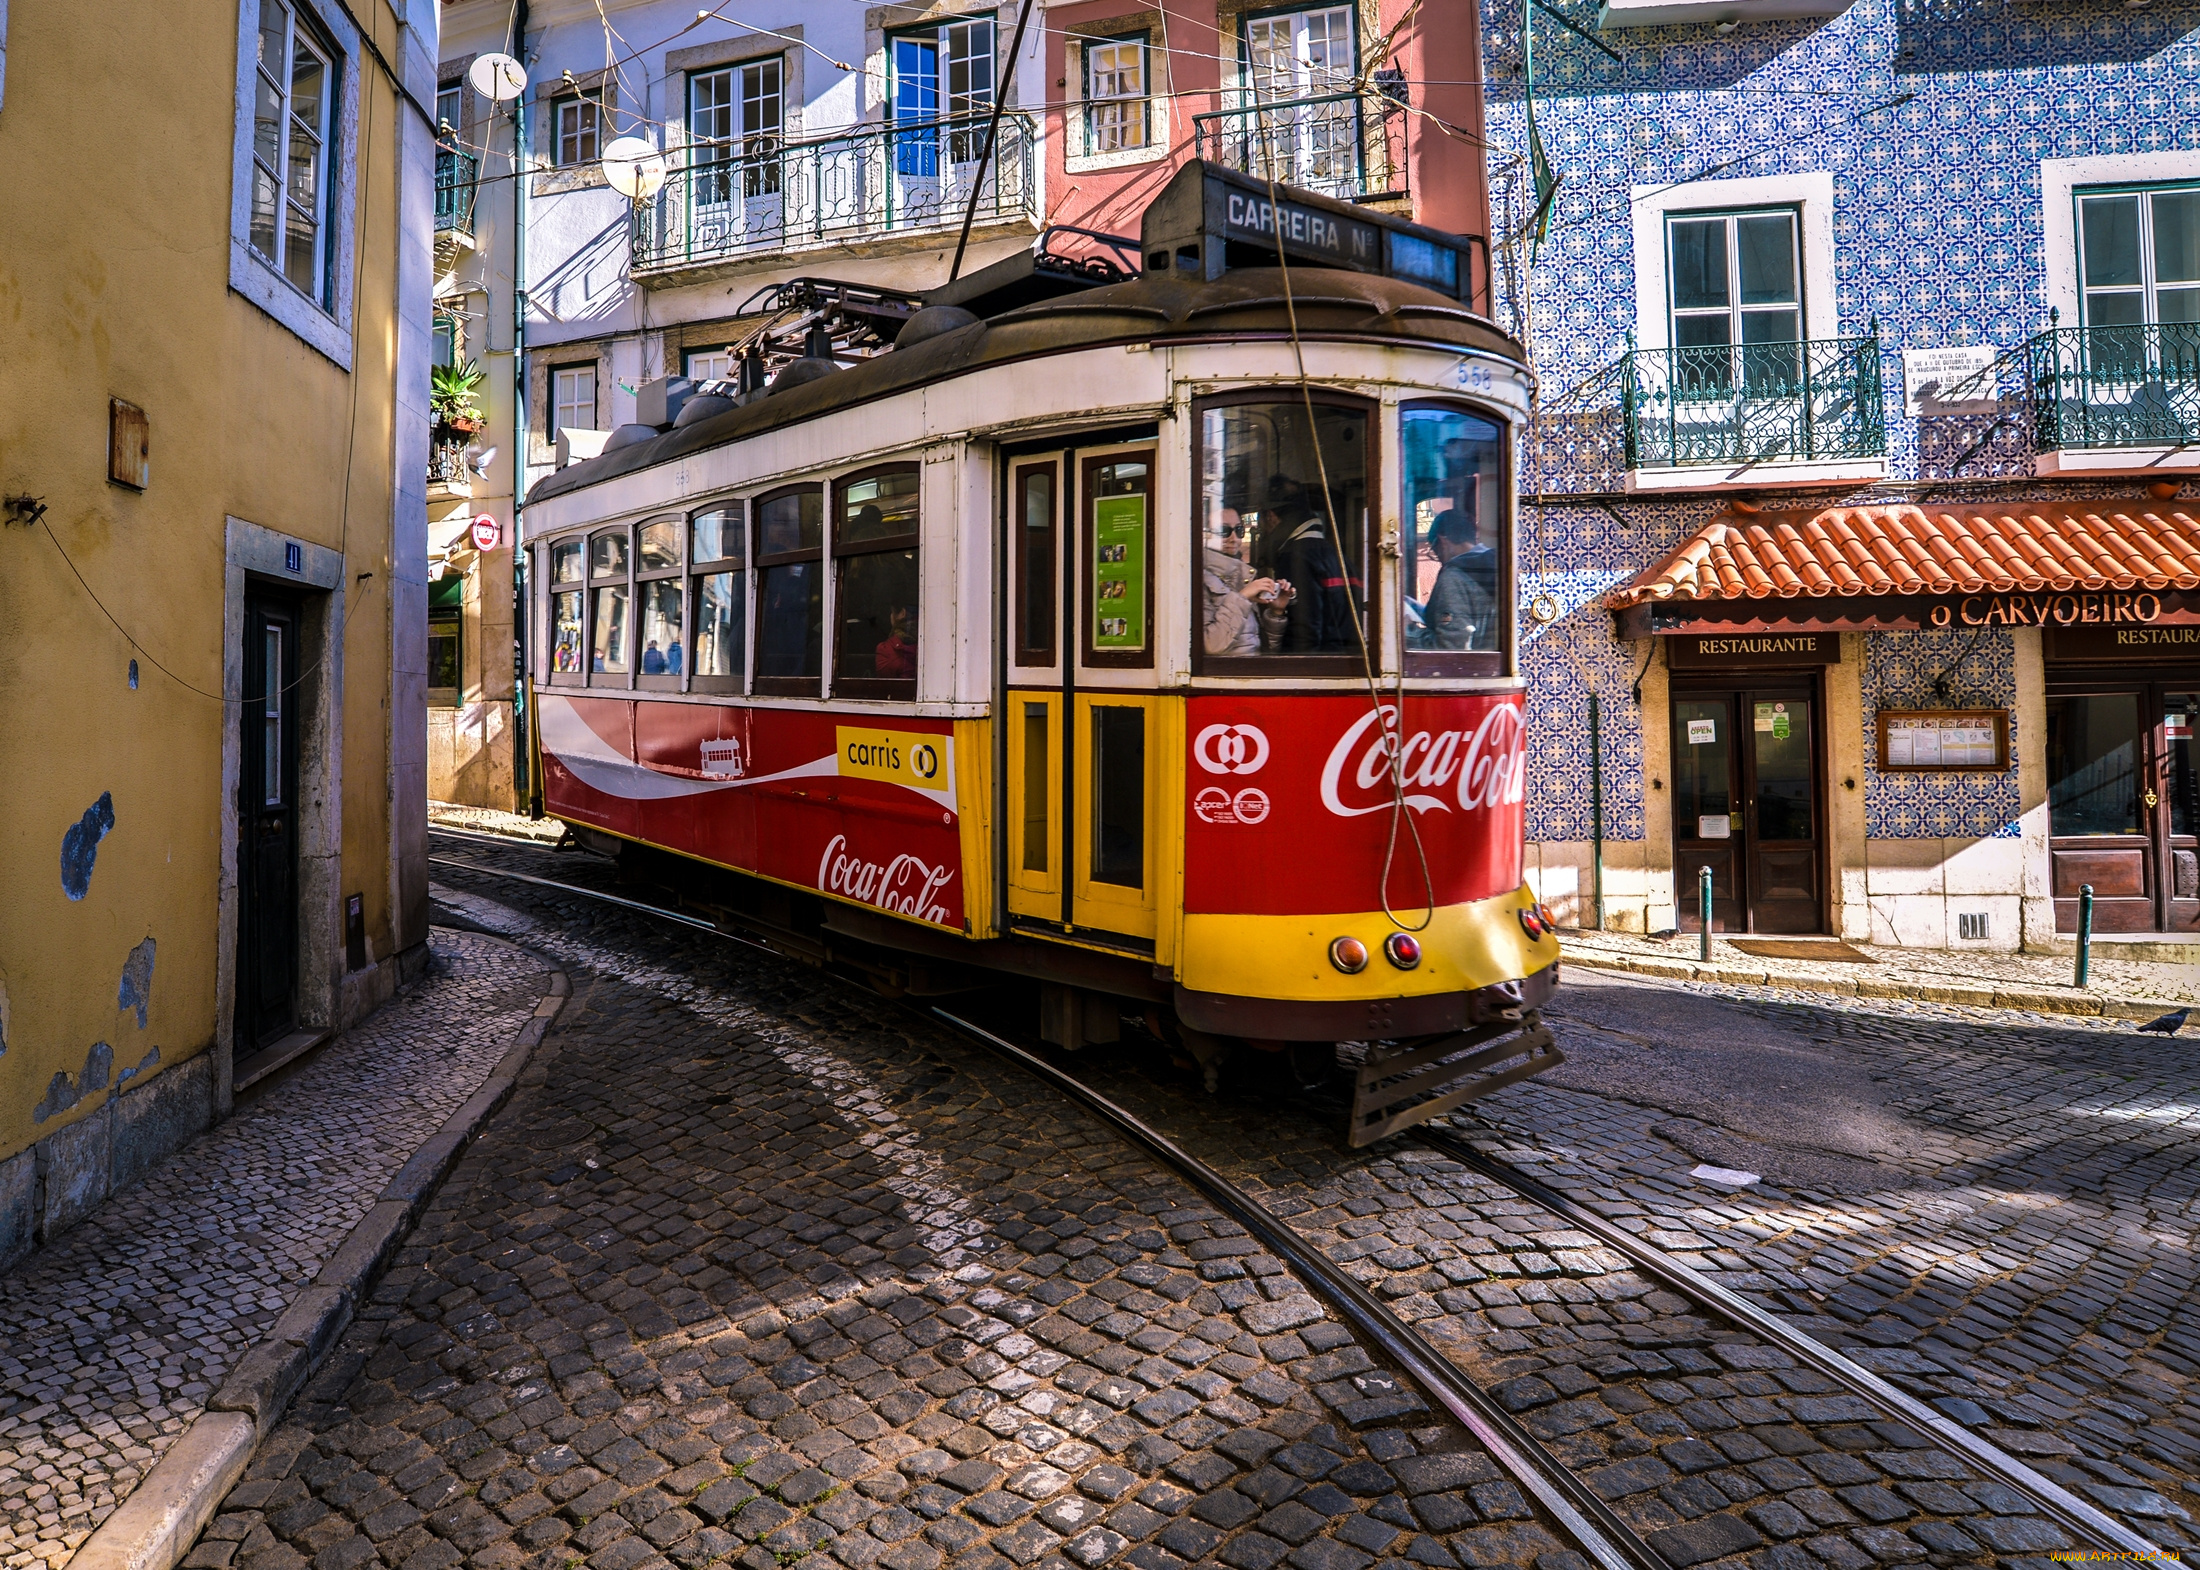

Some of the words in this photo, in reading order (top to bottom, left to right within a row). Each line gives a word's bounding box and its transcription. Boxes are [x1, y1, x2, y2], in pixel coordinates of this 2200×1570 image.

[1228, 193, 1340, 251] CARREIRA
[1458, 363, 1492, 390] 558
[289, 546, 299, 569] 41
[1961, 593, 2161, 625] CARVOEIRO
[1699, 637, 1817, 654] RESTAURANTE
[847, 737, 901, 770] carris
